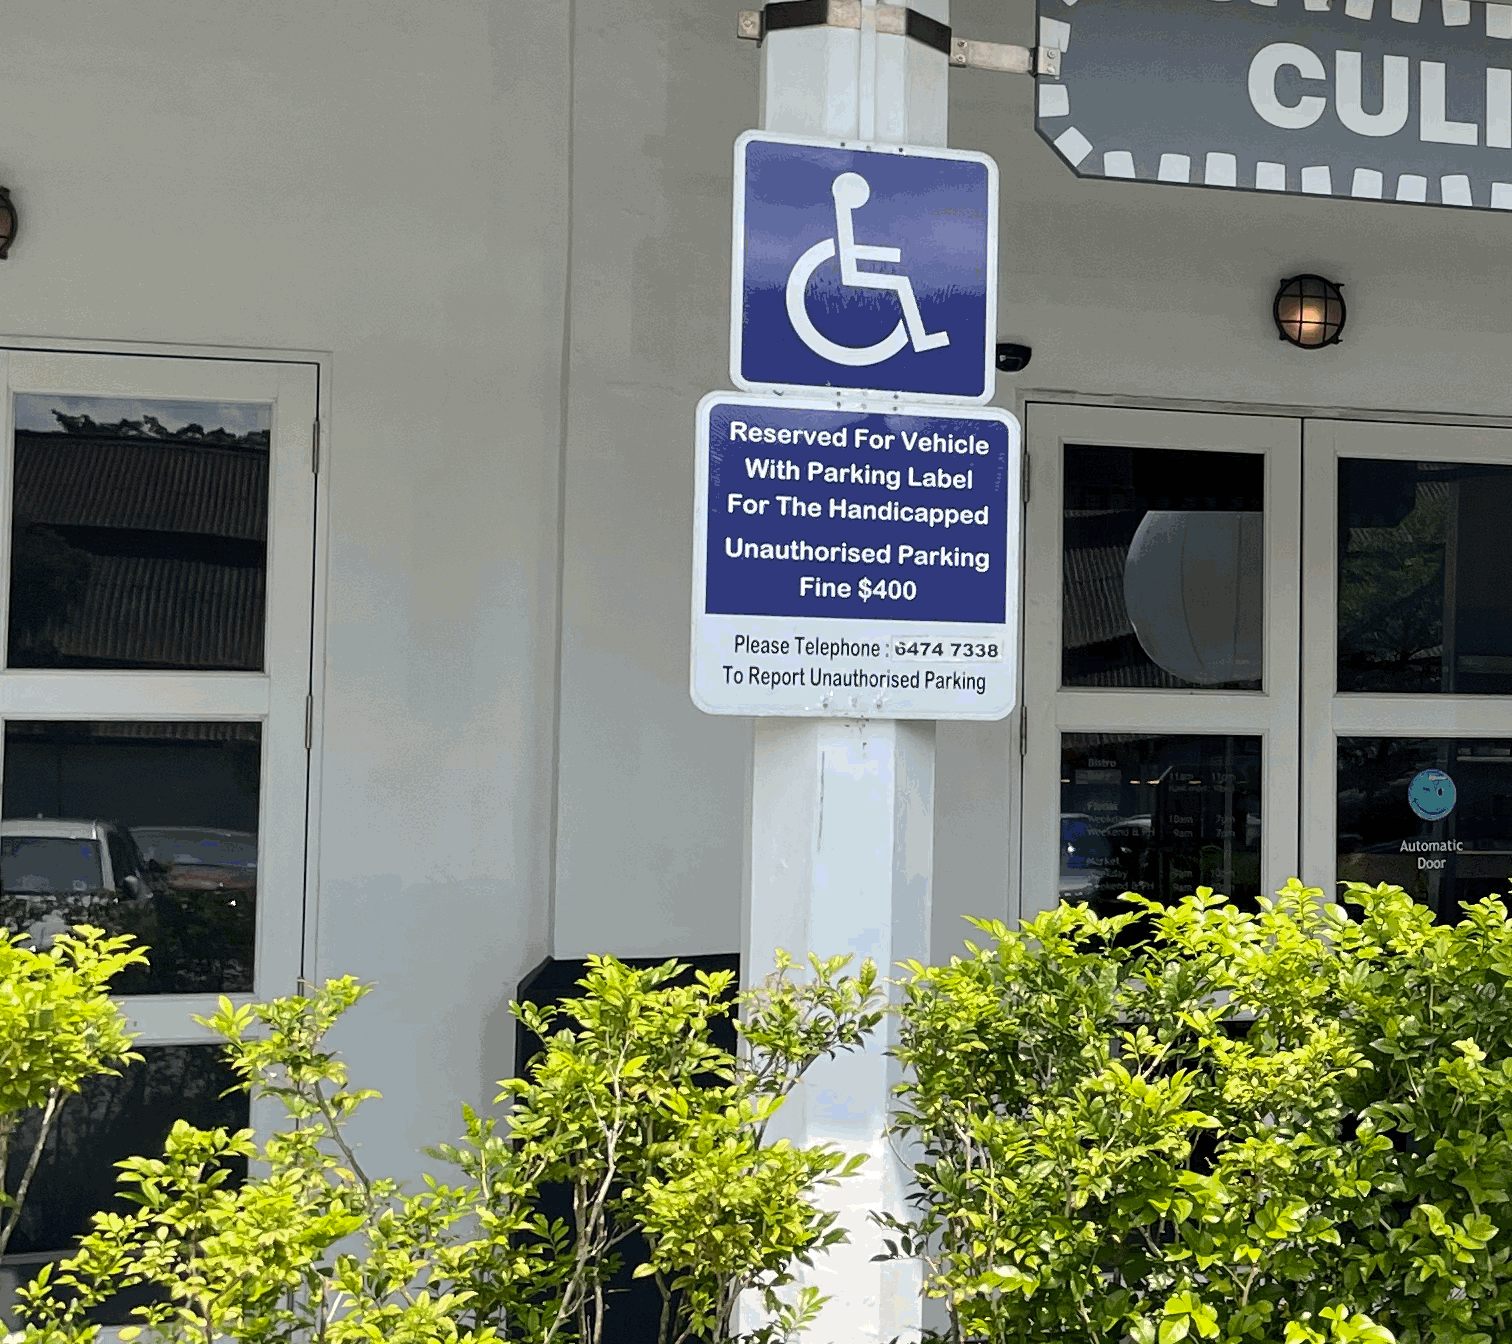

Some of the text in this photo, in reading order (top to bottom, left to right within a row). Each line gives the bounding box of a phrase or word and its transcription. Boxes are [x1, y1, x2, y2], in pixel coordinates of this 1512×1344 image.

[729, 420, 990, 456] Reserved For Vehicle
[744, 457, 973, 491] With Parking Label
[727, 493, 989, 529] For The Handicapped
[725, 536, 990, 573] Unauthorised Parking
[799, 576, 917, 603] Fine $400
[734, 634, 790, 657] Please
[795, 636, 881, 661] Telephone
[894, 641, 944, 658] 6474
[950, 642, 999, 658] 7338
[722, 665, 986, 695] To Report Unauthorised Parking
[1399, 839, 1464, 853] Automatic
[1417, 856, 1447, 870] Door
